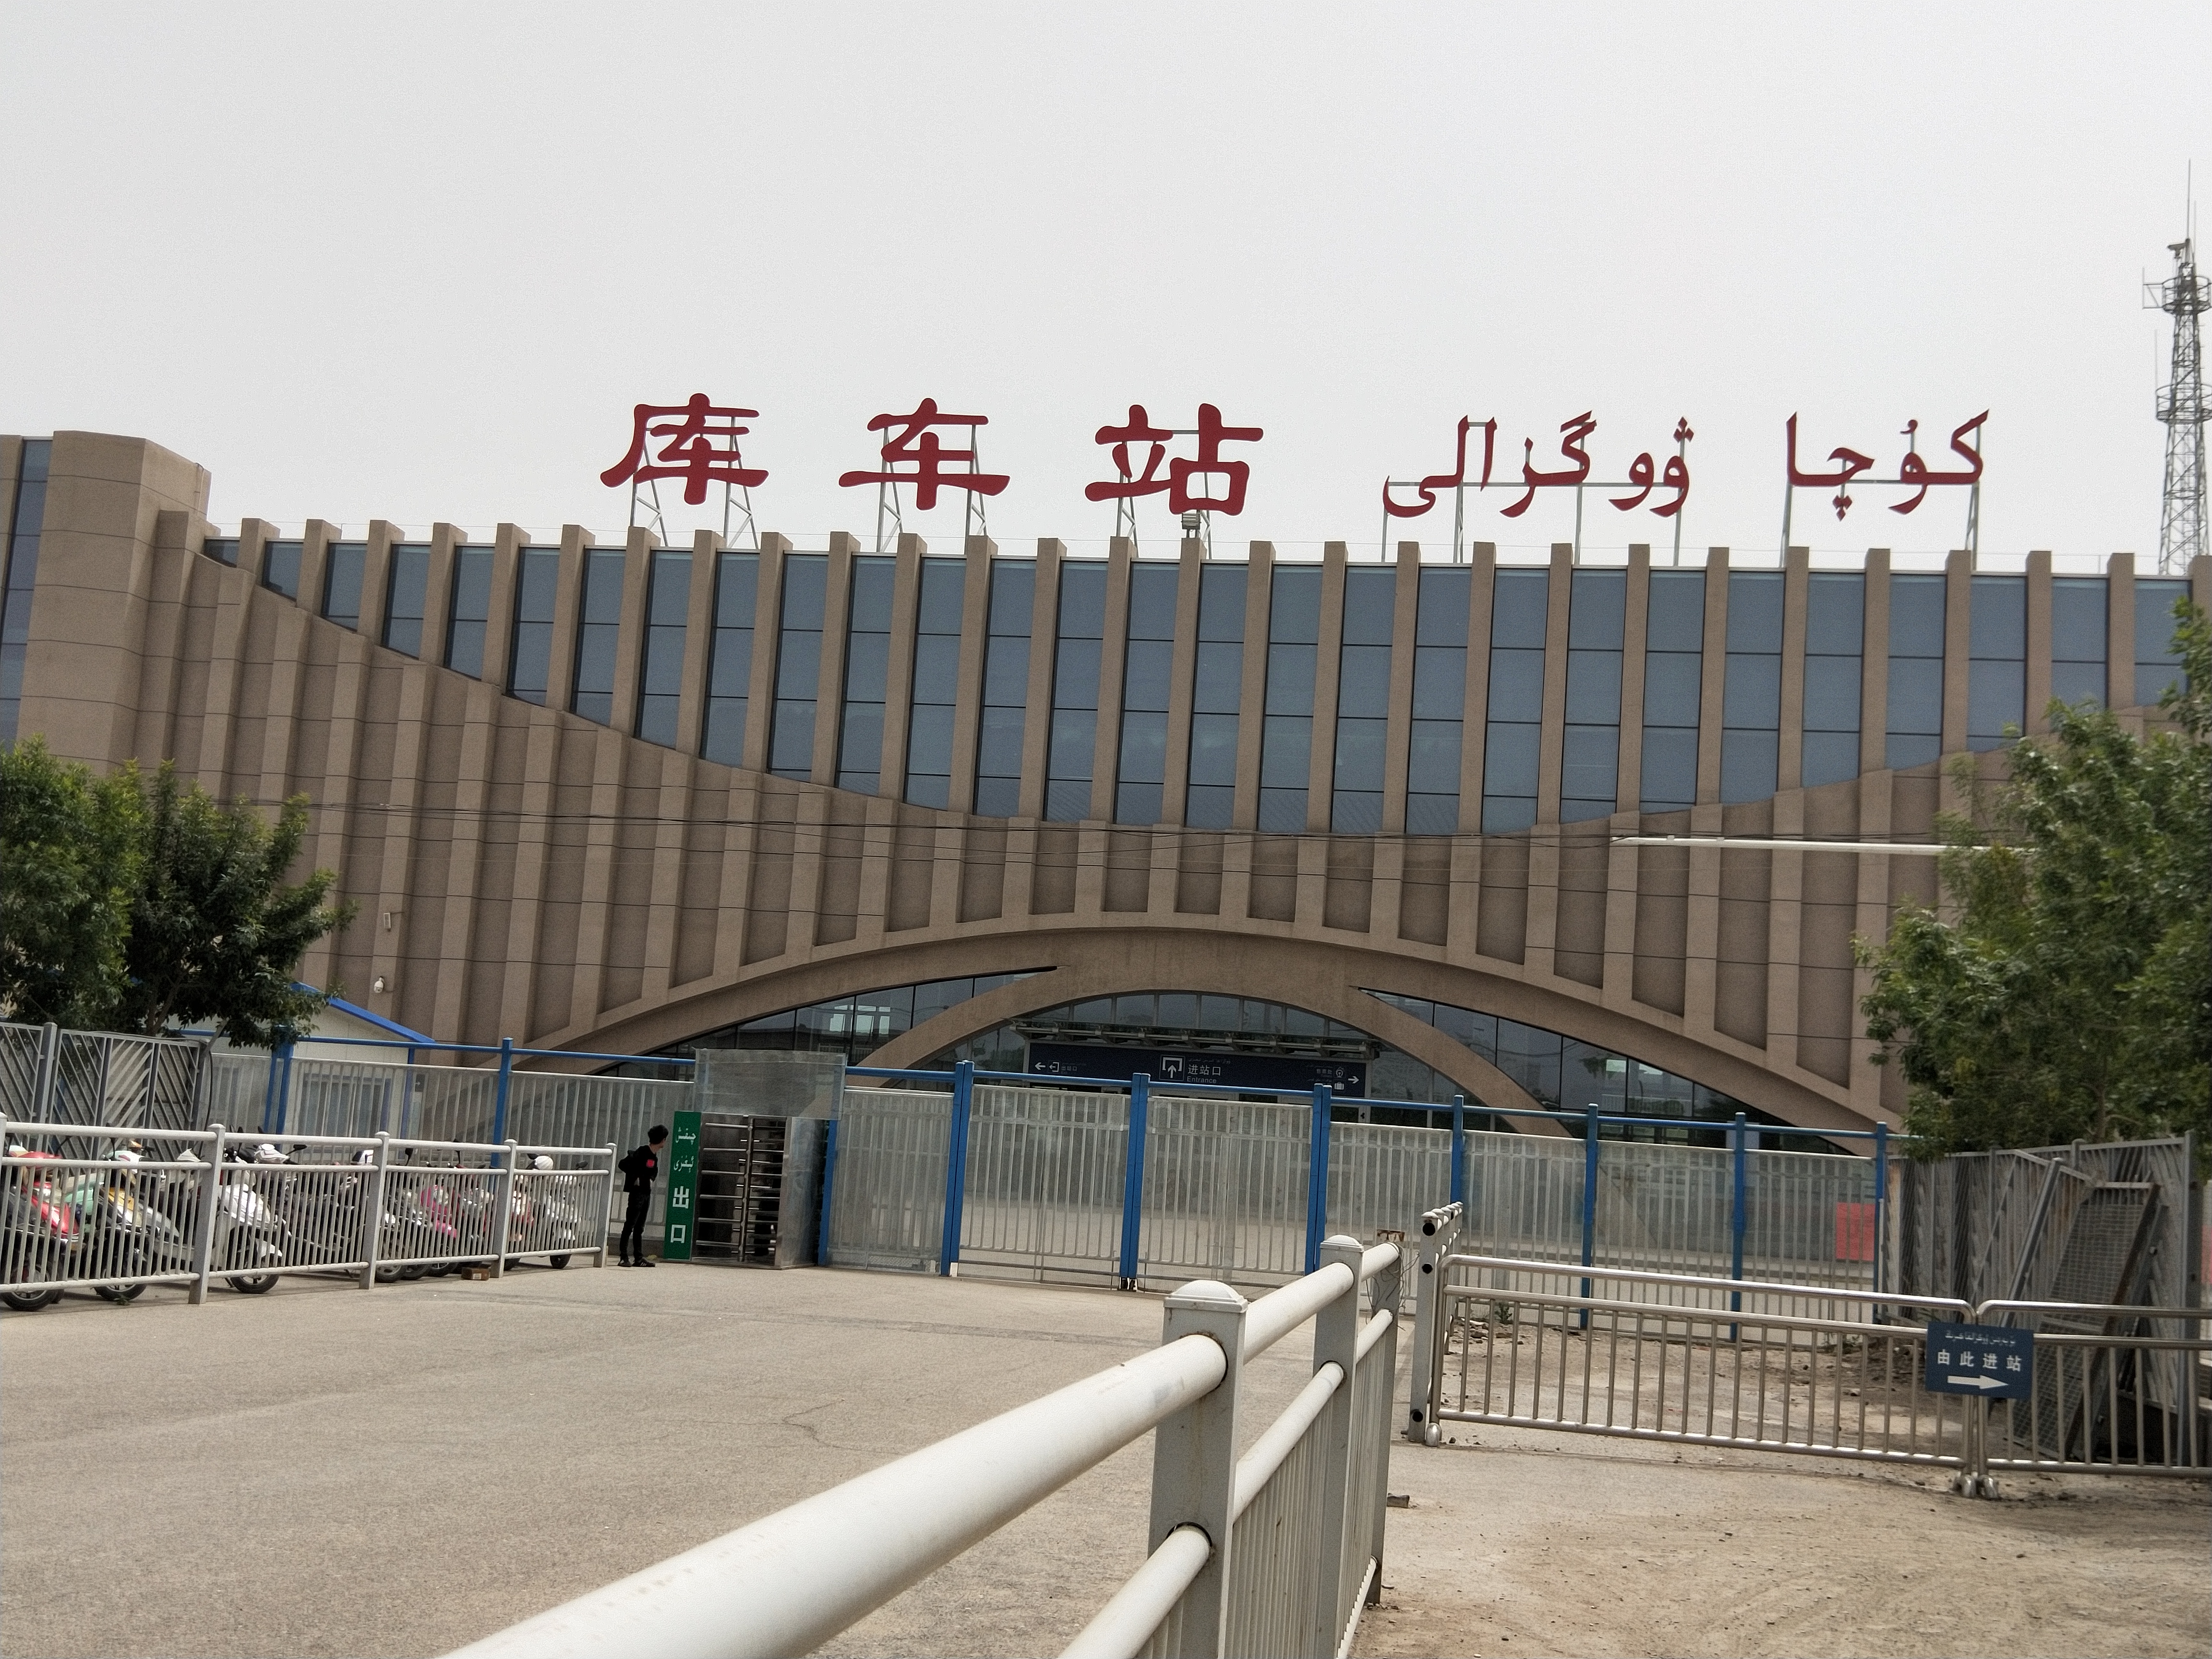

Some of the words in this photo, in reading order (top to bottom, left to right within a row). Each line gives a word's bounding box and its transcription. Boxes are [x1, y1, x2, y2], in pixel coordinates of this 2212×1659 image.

[601, 394, 1262, 515] 库车站
[1187, 1076, 1217, 1084] Entrance
[1188, 1064, 1221, 1076] 进站口
[670, 1186, 690, 1243] 出口
[1937, 1349, 2022, 1372] 由此进站
